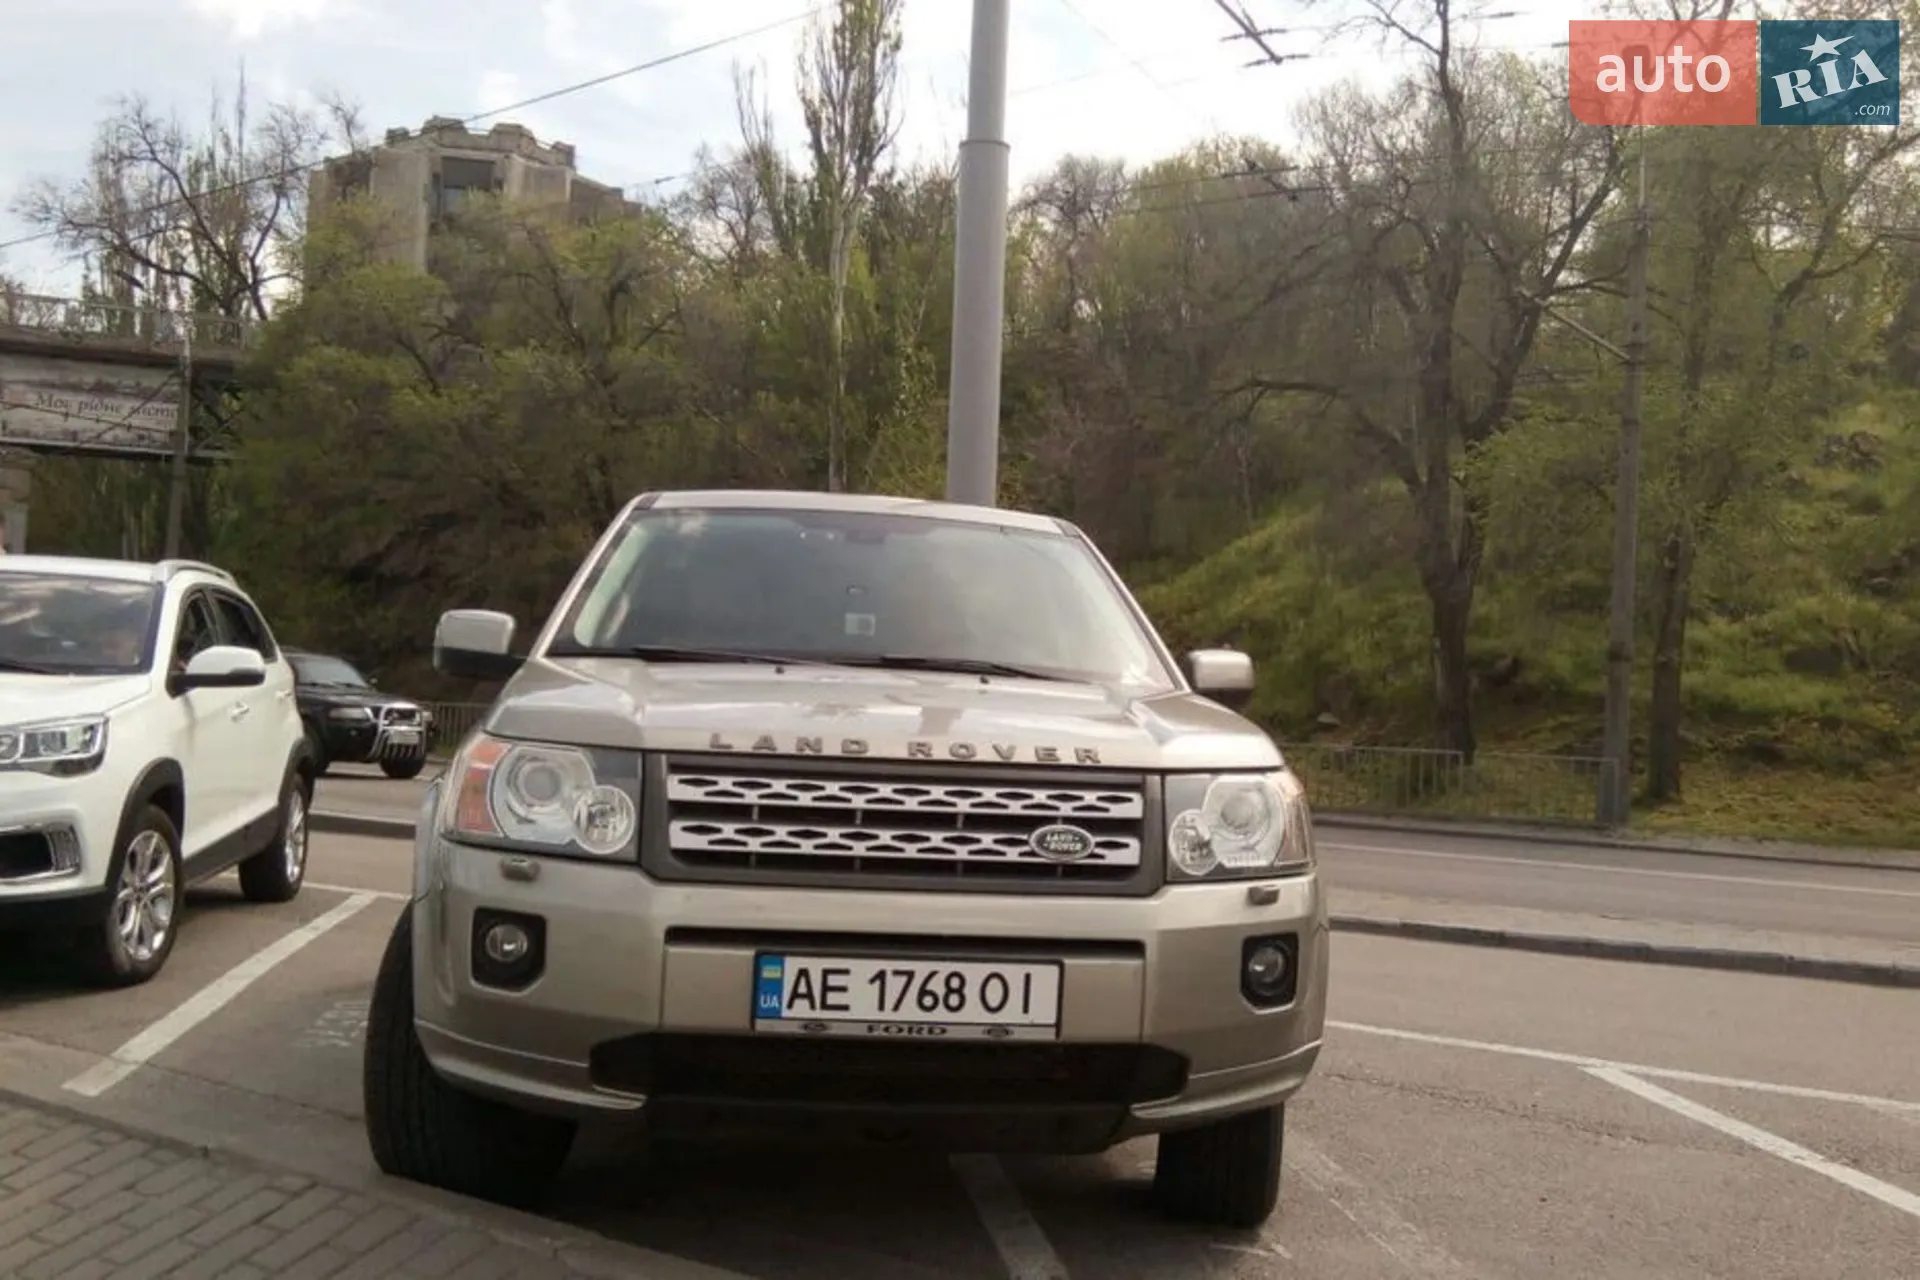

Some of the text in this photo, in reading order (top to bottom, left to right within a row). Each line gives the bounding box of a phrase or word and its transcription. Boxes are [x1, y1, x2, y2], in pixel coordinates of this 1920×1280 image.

[709, 733, 1102, 765] LAND ROVER
[760, 994, 780, 1009] UA
[786, 967, 1032, 1015] AE 1768 OI
[866, 1023, 948, 1036] FORD
